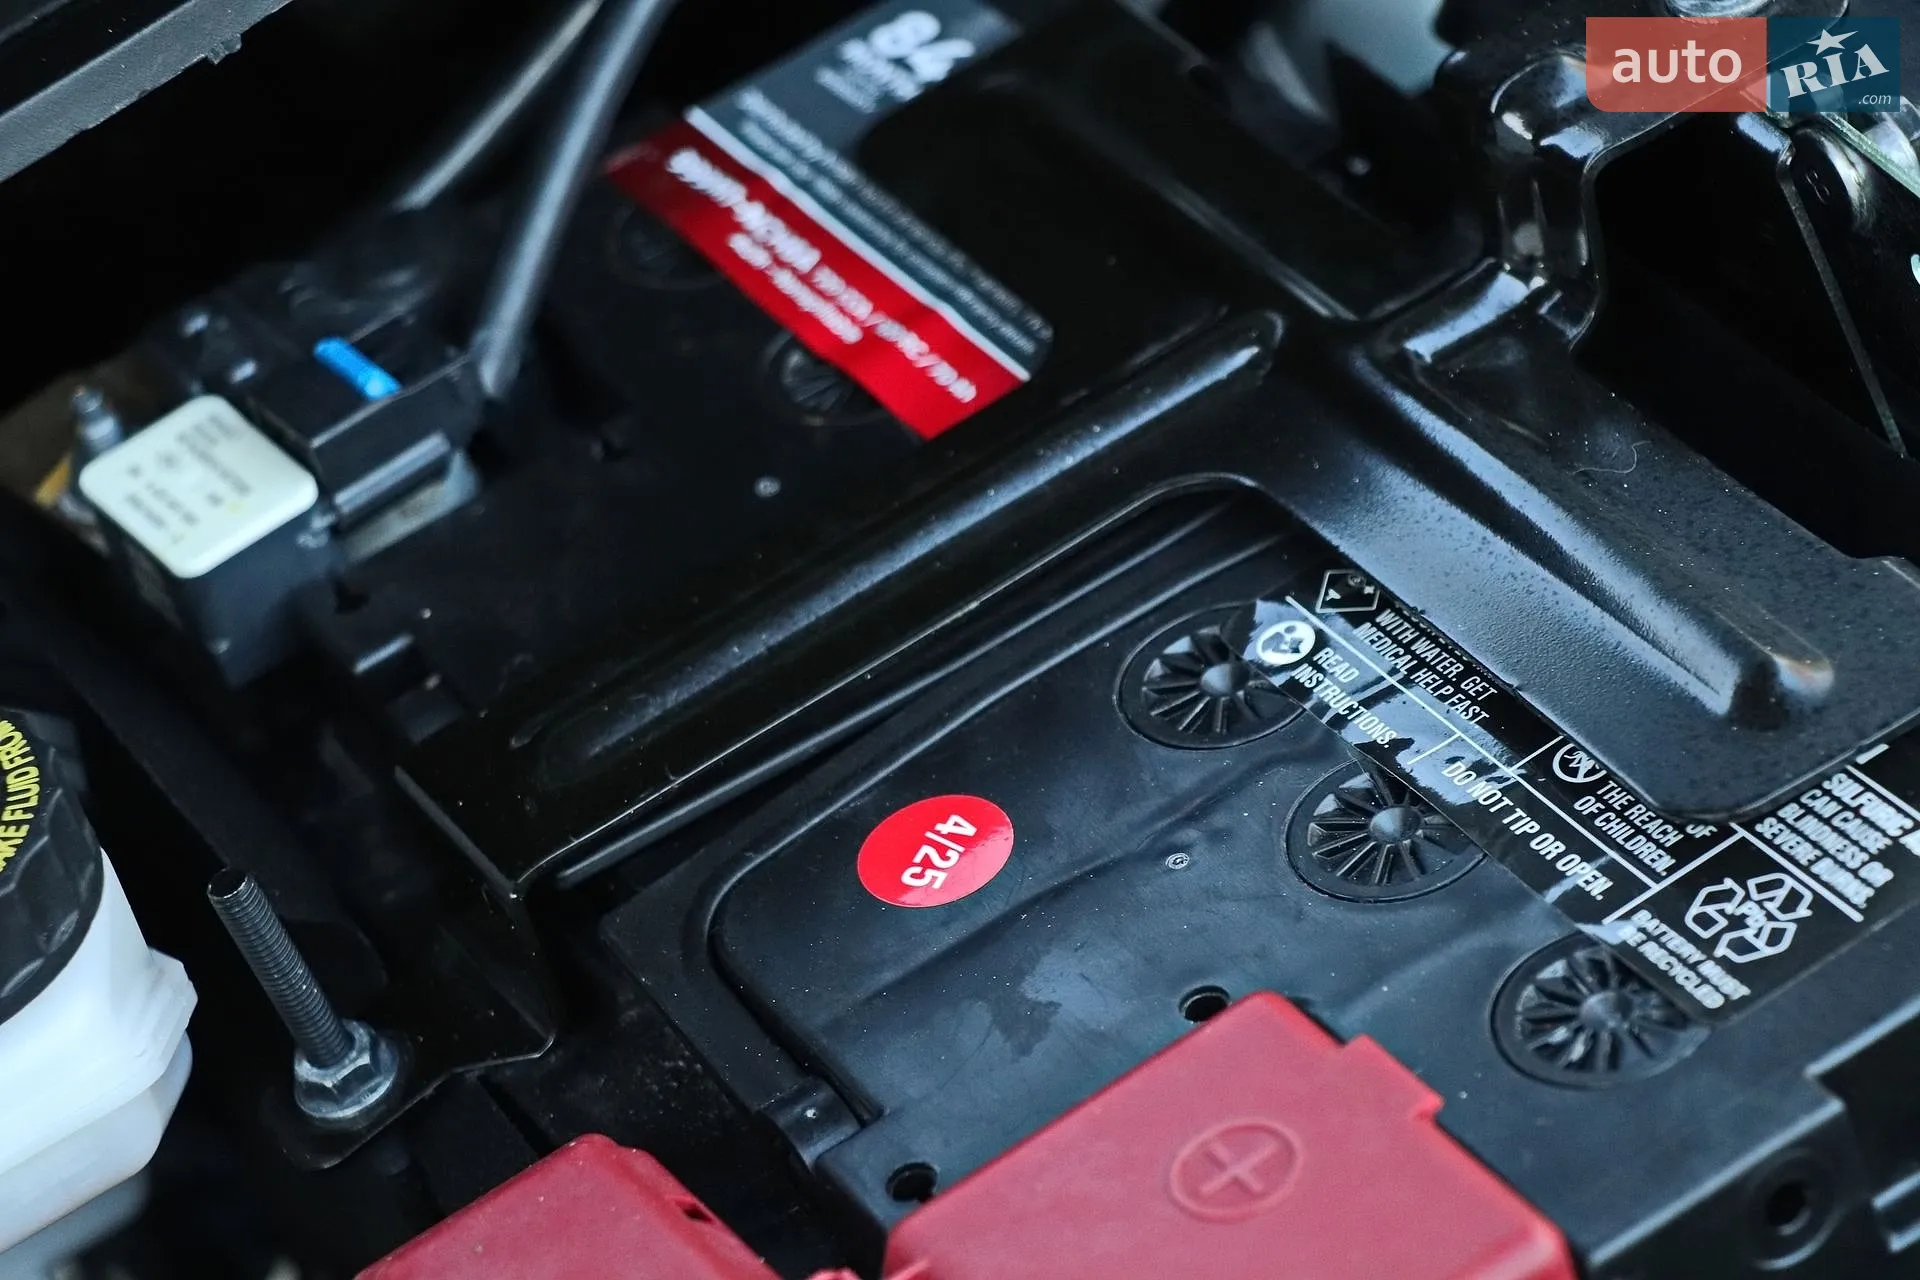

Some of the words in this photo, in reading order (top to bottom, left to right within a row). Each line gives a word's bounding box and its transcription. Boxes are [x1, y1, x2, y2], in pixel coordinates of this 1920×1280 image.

[1312, 647, 1360, 684] READ
[1352, 622, 1418, 675] MEDICAL
[1409, 668, 1455, 700] HELP
[1374, 609, 1419, 644] WITH
[1410, 636, 1465, 682] WATER.
[1460, 676, 1498, 700] GET
[1292, 663, 1397, 748] INSTRUCTIONS.
[1, 766, 40, 821] FLUID
[1596, 780, 1635, 811] THE
[1630, 804, 1684, 847] REACH
[1800, 789, 1843, 818] CAN
[901, 814, 978, 889] 4/25
[1441, 760, 1477, 787] DO
[1467, 780, 1514, 813] NOT
[1502, 808, 1541, 840] TIP
[1529, 832, 1566, 861] OR
[1555, 853, 1615, 901] OPEN.
[1573, 795, 1606, 816] OF
[1594, 810, 1676, 877] CHILDREN.
[1754, 817, 1824, 866] SEVERE
[1631, 909, 1707, 964] BATTERY
